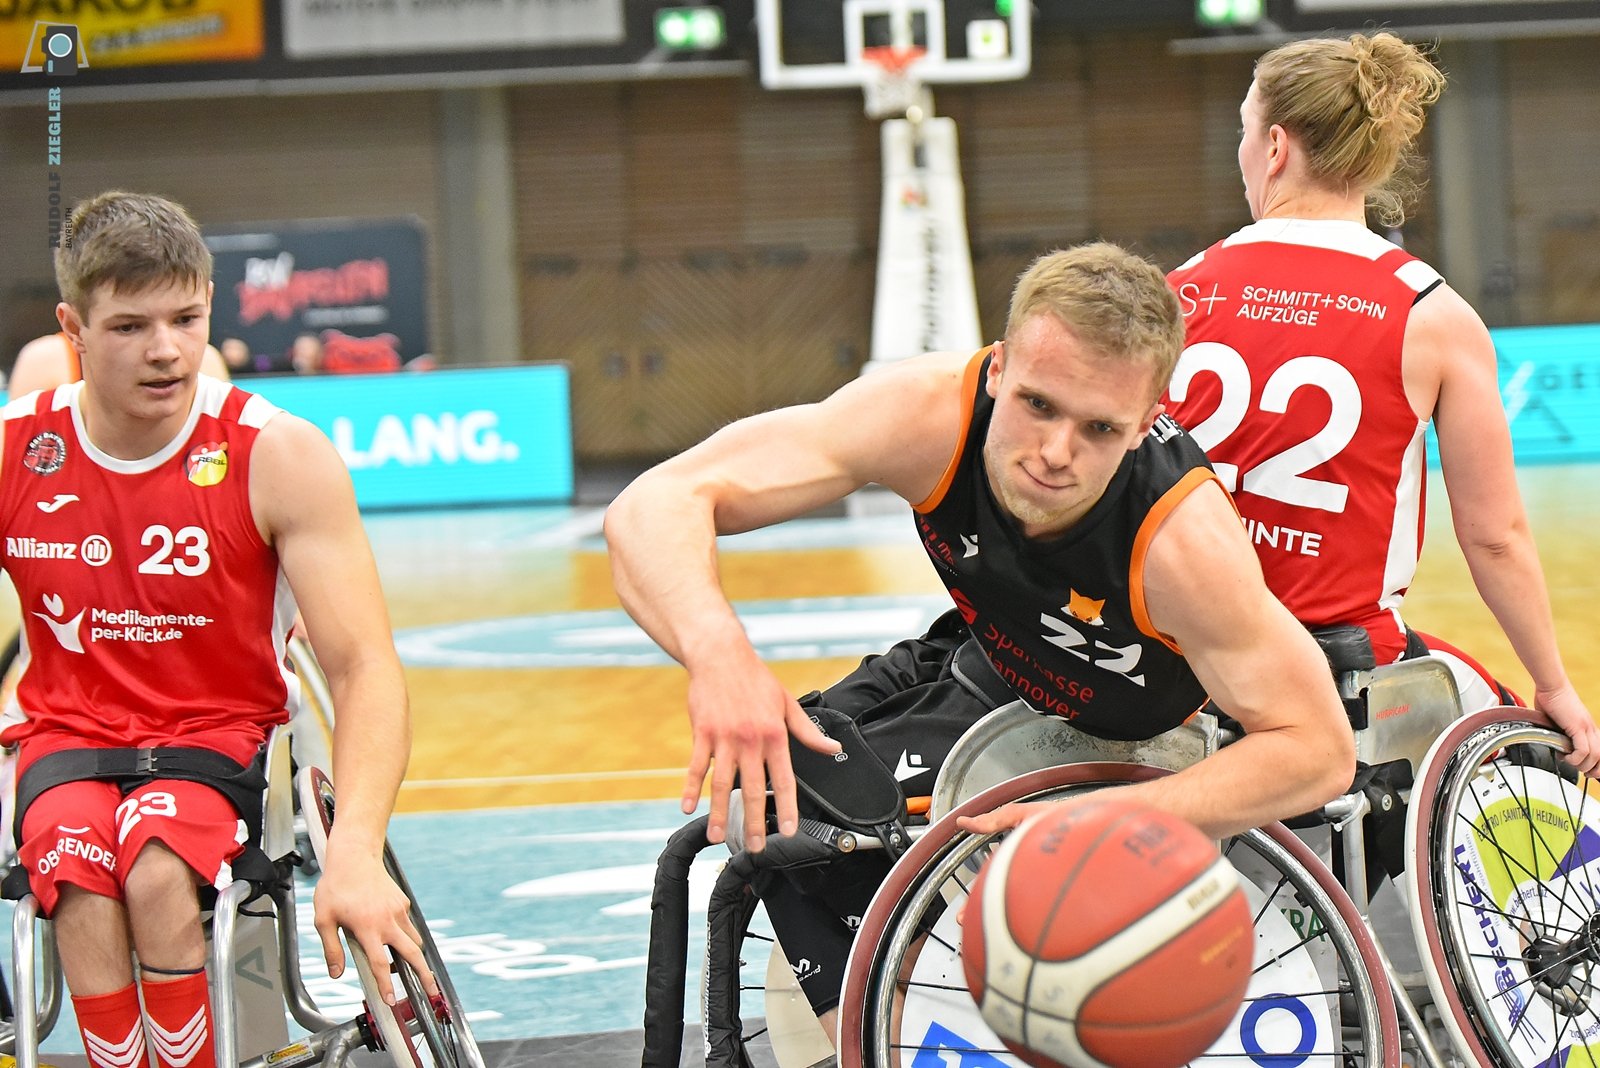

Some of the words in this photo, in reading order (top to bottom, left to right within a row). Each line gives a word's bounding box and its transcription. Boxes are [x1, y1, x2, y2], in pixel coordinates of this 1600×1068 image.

[1236, 302, 1320, 326] AUFZÜGE
[1241, 286, 1387, 320] SCHMITT+SOHN
[1168, 341, 1363, 514] 22
[7, 537, 77, 560] Allianz
[138, 524, 211, 577] 23
[1242, 516, 1323, 557] INTE
[91, 608, 214, 627] Medikamente-
[91, 625, 183, 643] per-Klick.de
[1040, 612, 1147, 688] 22
[115, 791, 178, 845] 23
[1536, 809, 1569, 832] HEIZUNG
[1455, 843, 1518, 990] BECHERT
